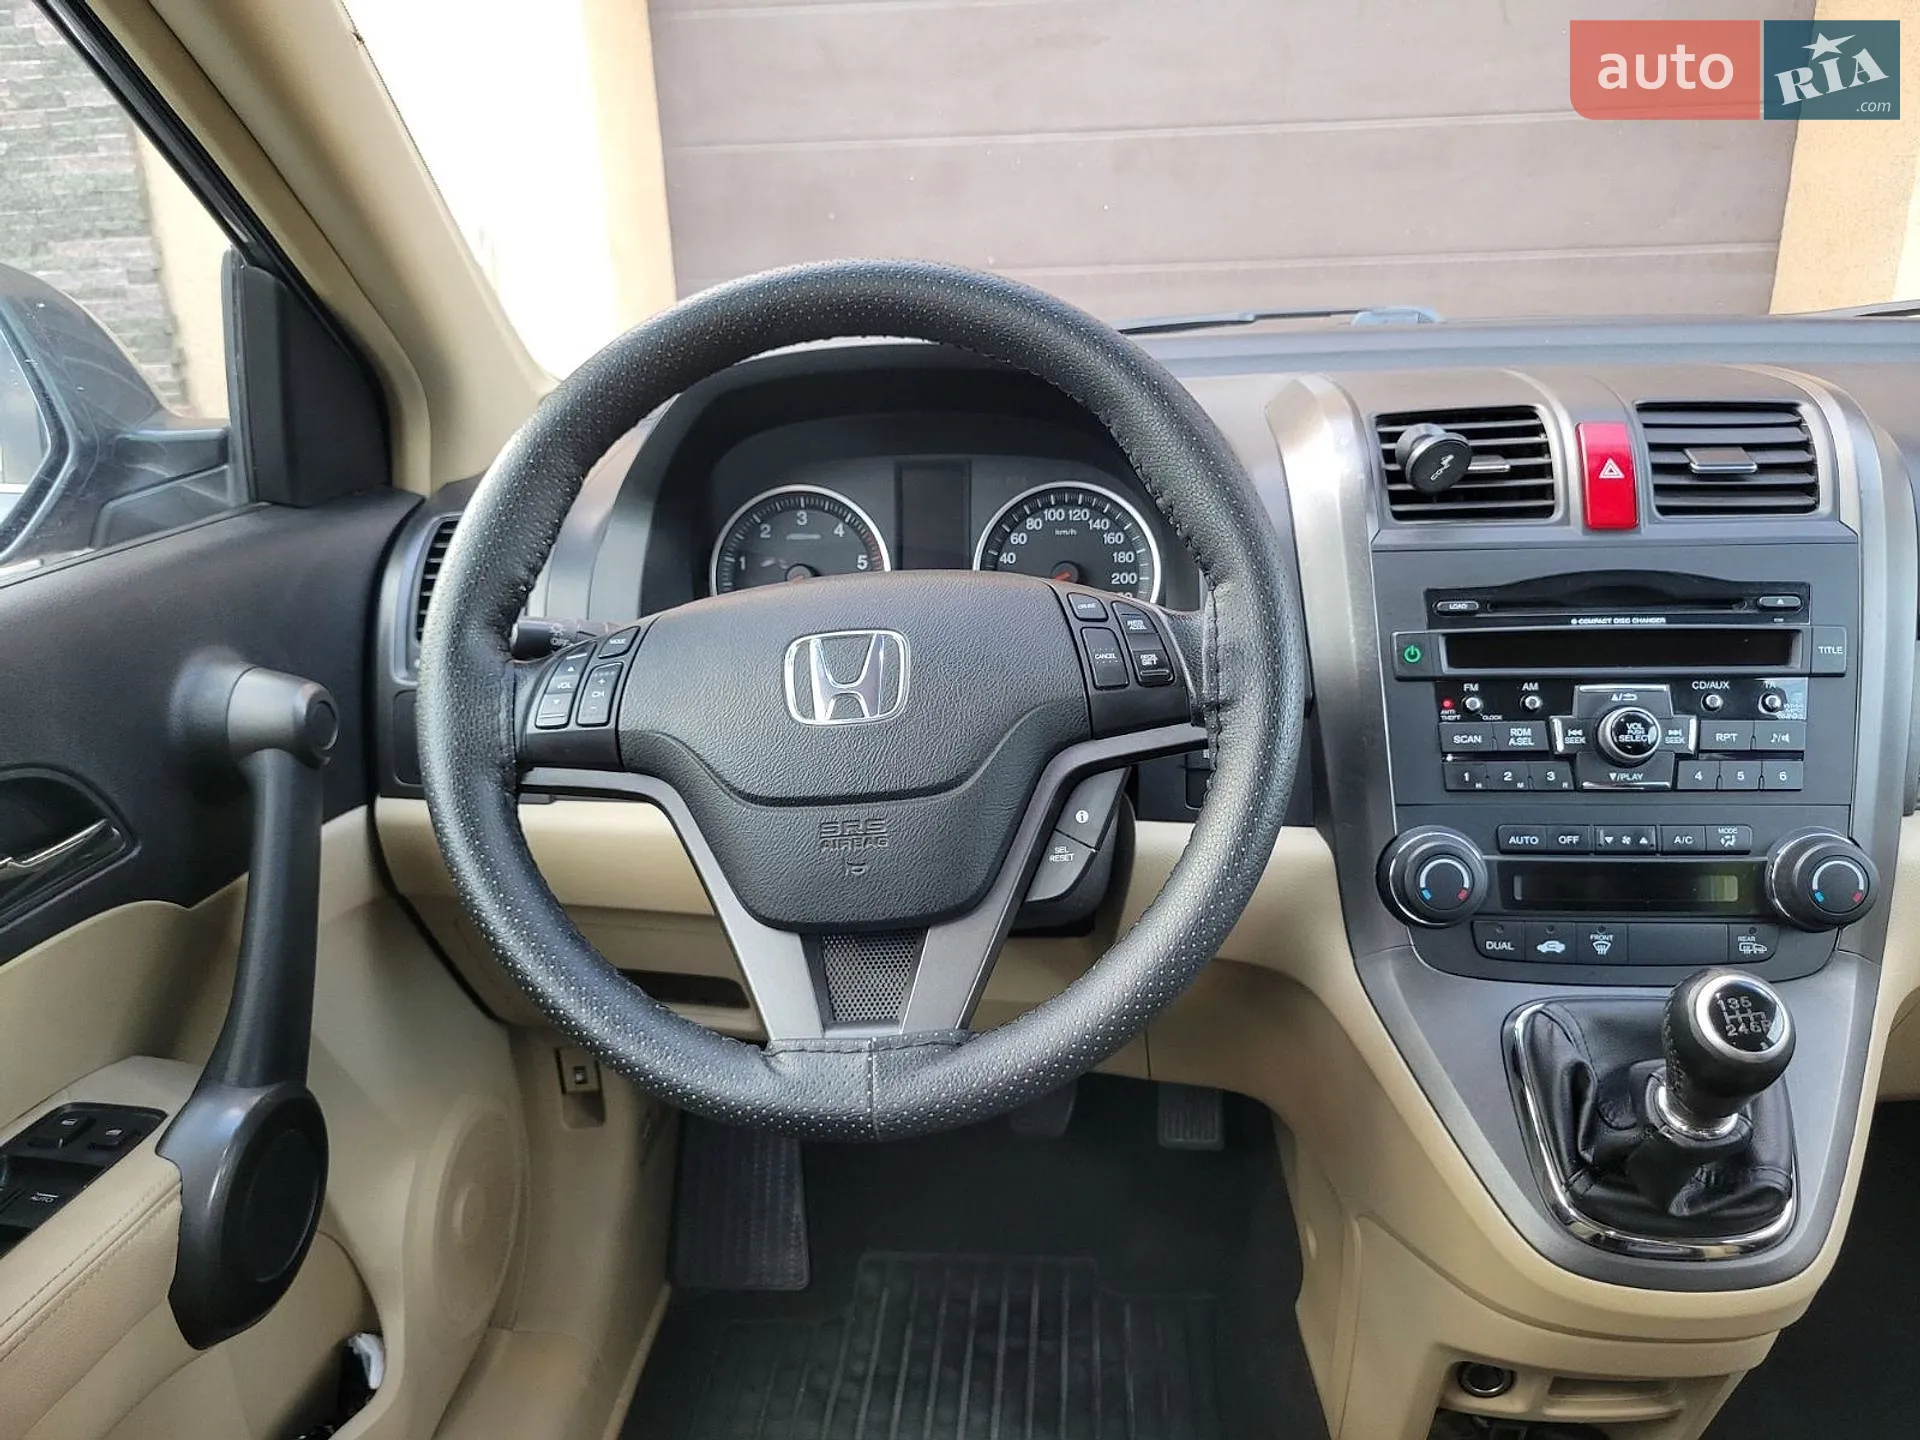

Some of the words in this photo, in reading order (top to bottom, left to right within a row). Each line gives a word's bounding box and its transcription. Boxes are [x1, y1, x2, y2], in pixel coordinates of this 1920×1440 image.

[796, 511, 808, 526] 3
[1044, 509, 1065, 521] 100
[1069, 509, 1090, 521] 120
[1026, 518, 1043, 531] 80
[1088, 518, 1110, 531] 140
[760, 523, 771, 538] 2
[833, 523, 845, 538] 4
[1055, 528, 1077, 536] km/h
[1010, 532, 1027, 545] 60
[1103, 532, 1124, 545] 160
[999, 552, 1017, 564] 40
[1112, 551, 1135, 563] 180
[739, 556, 746, 570] 1
[857, 555, 868, 570] 5
[1111, 572, 1138, 585] 200
[1818, 645, 1844, 654] TITLE
[1463, 683, 1479, 692] FM
[1521, 682, 1539, 691] AM
[1692, 680, 1730, 690] CD/AUX
[1626, 722, 1645, 730] VOL
[1509, 727, 1532, 736] RDM
[1453, 735, 1482, 744] SCAN
[1564, 736, 1586, 744] SEEK
[1665, 736, 1685, 744] SEEK
[1715, 733, 1738, 742] RPT
[1463, 772, 1470, 781] 1
[1503, 771, 1512, 781] 2
[1546, 771, 1556, 781] 3
[1694, 771, 1703, 781] 4
[1737, 771, 1745, 781] 5
[1779, 771, 1787, 781] 6
[1508, 836, 1539, 845] AUTO
[1558, 835, 1580, 845] OFF
[1673, 836, 1694, 845] A/C
[1054, 845, 1069, 853] SEL
[1049, 853, 1075, 862] RESET
[1485, 940, 1515, 950] DUAL
[1727, 997, 1740, 1010] 3
[1740, 996, 1752, 1008] 5
[1726, 1024, 1739, 1037] 2
[1738, 1022, 1749, 1035] 4
[1750, 1021, 1762, 1033] 6
